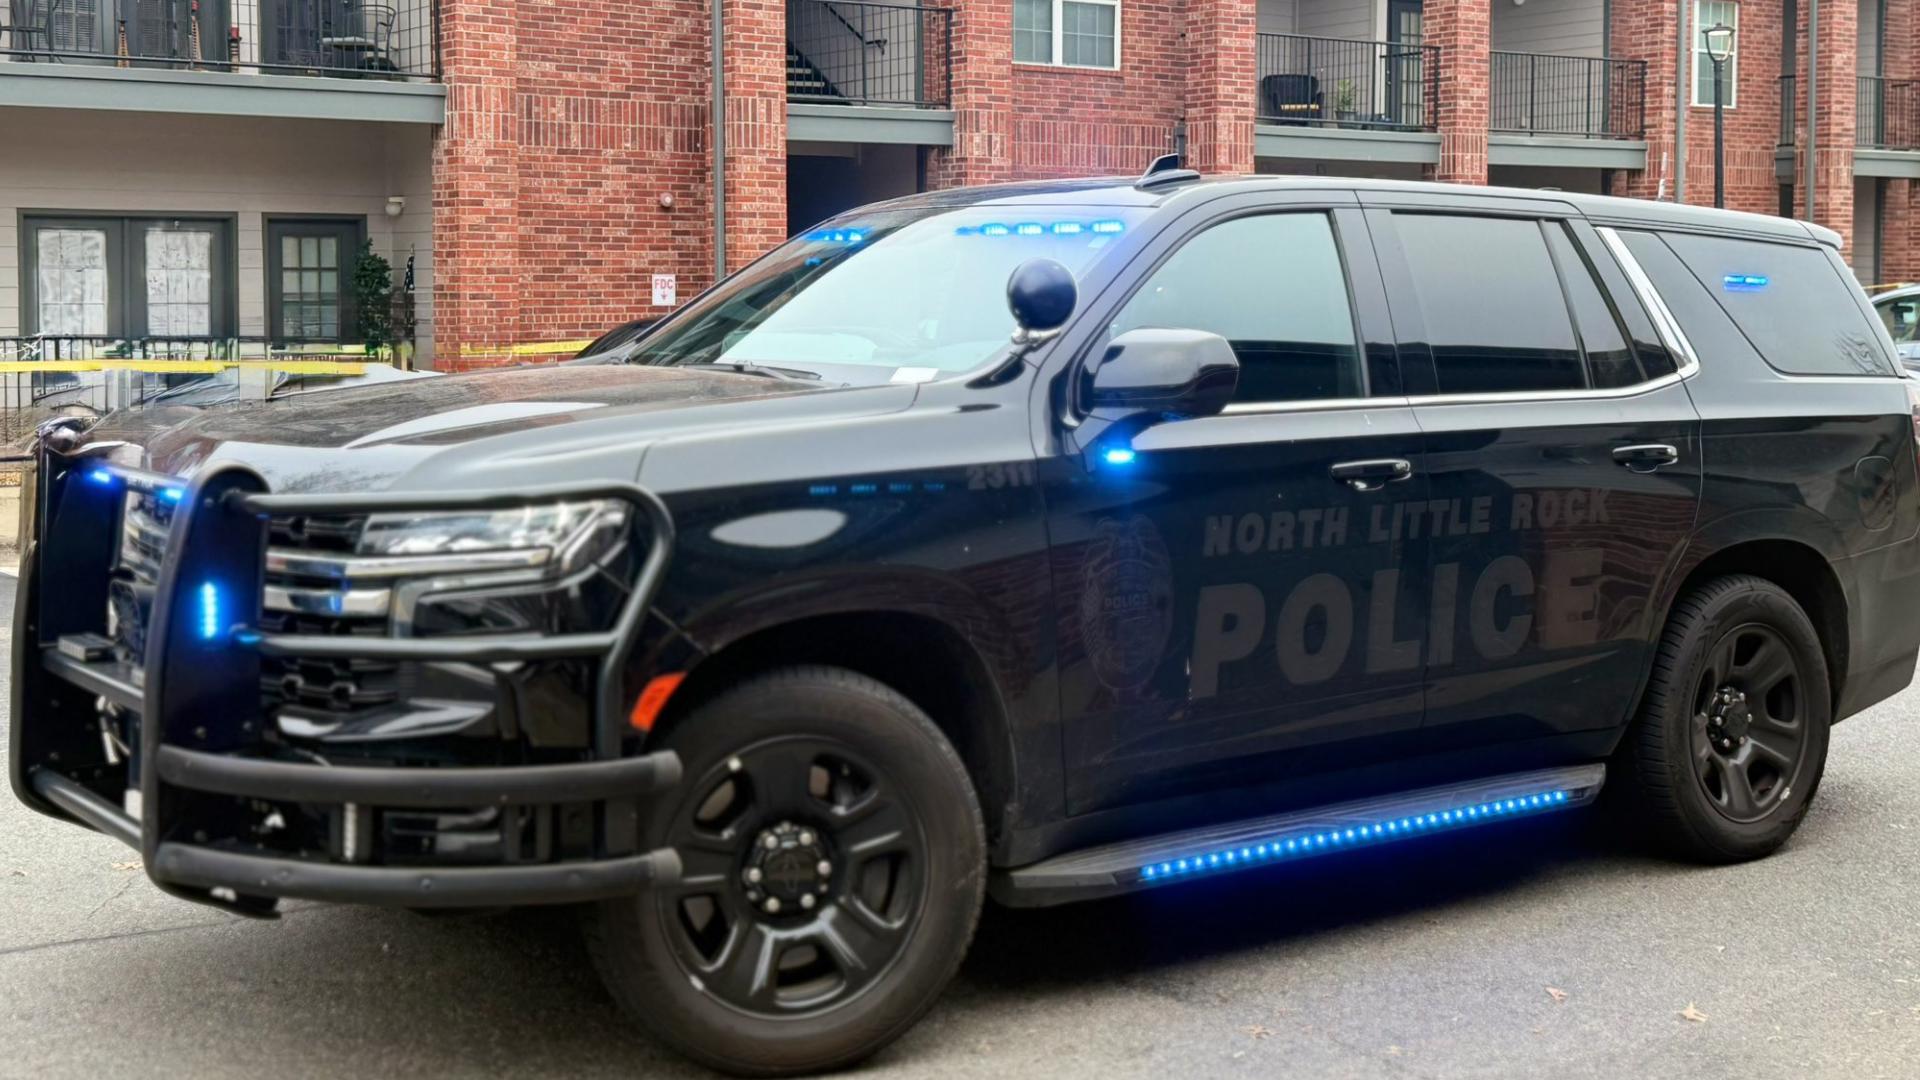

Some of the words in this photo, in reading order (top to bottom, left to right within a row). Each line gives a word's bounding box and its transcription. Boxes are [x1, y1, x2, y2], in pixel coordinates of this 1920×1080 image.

[654, 278, 674, 290] FDC
[966, 460, 1034, 491] 2311
[1203, 507, 1349, 557] NORTH
[1369, 496, 1492, 543] LITTLE
[1510, 487, 1611, 530] ROCK
[1104, 593, 1149, 609] POLICE
[1190, 547, 1604, 699] POLICE
